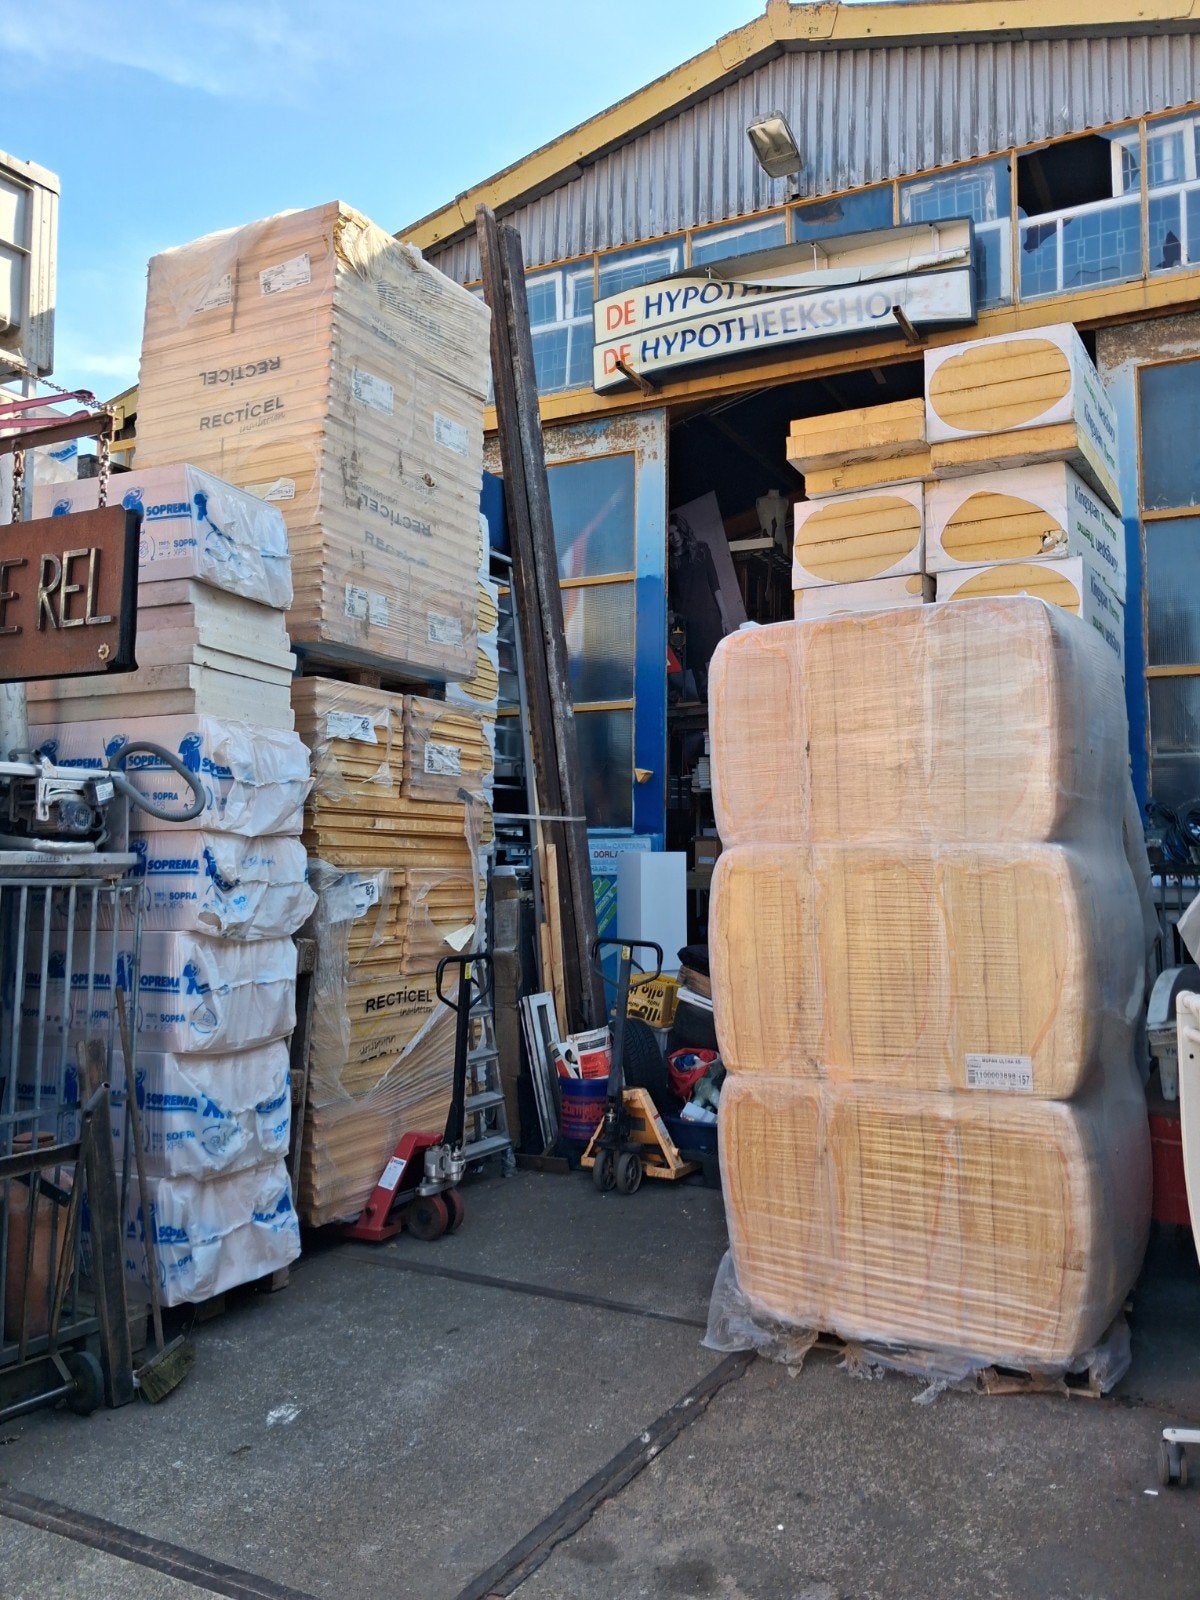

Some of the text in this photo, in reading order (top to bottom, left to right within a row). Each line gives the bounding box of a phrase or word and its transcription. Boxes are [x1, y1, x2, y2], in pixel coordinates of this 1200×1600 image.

[606, 299, 636, 331] DE
[199, 356, 281, 386] RECTICEL
[603, 343, 634, 375] DE
[200, 396, 285, 431] RECTICEL
[1074, 483, 1101, 521] Kingspan
[36, 547, 113, 631] REL
[152, 792, 179, 801] SOPRA
[147, 859, 199, 870] SOPREMA
[169, 891, 197, 900] SOPRA
[366, 985, 433, 1014] RECTICEL
[145, 1092, 198, 1108] SOPREMA
